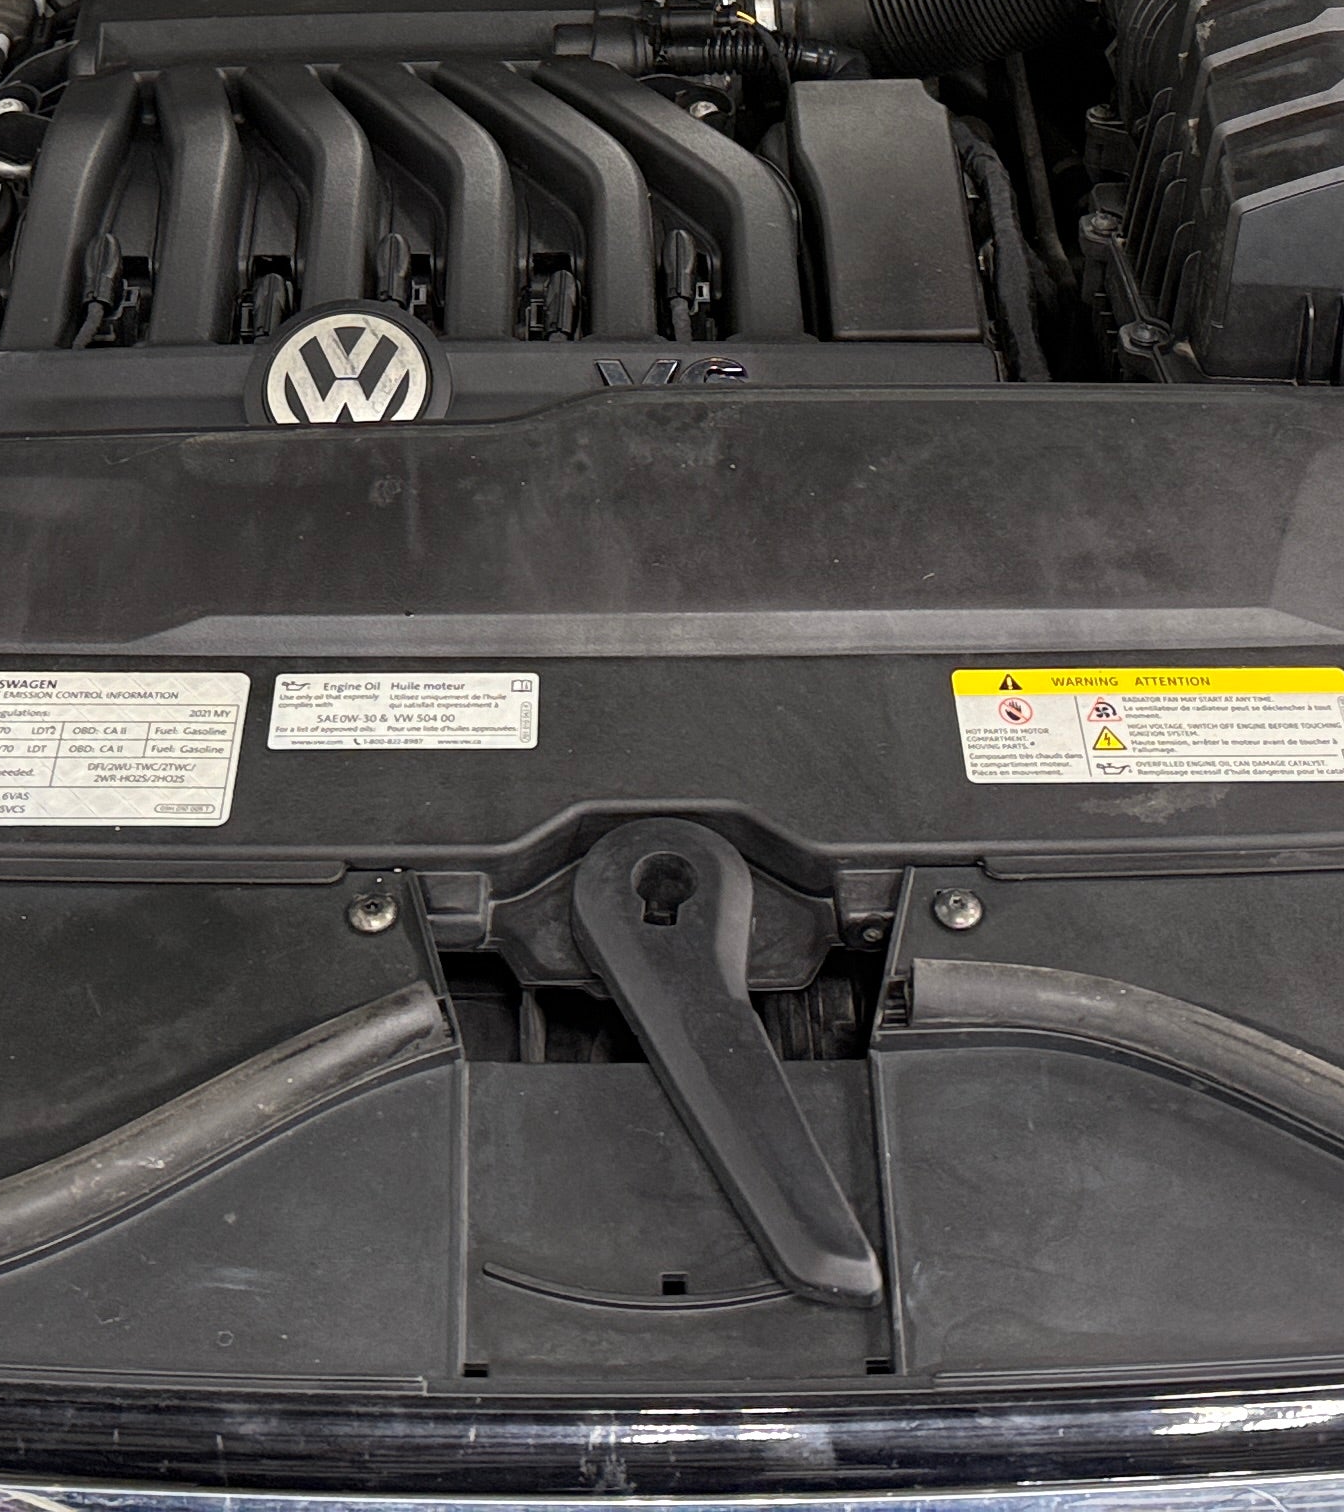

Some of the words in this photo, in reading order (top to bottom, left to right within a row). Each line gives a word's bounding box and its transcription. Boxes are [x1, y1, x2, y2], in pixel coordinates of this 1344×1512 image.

[1051, 676, 1118, 687] WARNING
[1135, 676, 1210, 686] ATTENTION
[323, 682, 362, 693] Engine
[365, 682, 381, 690] Oil
[391, 682, 420, 690] Huile
[424, 682, 465, 690] moteur
[4, 691, 53, 699] EMISSION
[56, 691, 103, 699] CONTROL
[107, 691, 179, 700] INFORMATION
[189, 710, 211, 718] 2021
[214, 710, 231, 718] MY
[379, 714, 388, 722] &
[394, 714, 413, 722] VW
[417, 714, 437, 722] 504
[441, 714, 455, 722] 00
[32, 726, 56, 735] LDT2
[73, 727, 98, 735] OBD:
[103, 727, 119, 735] CA
[155, 727, 178, 735] Fuel:
[183, 727, 227, 736] Gasoline
[27, 745, 47, 753] LDT
[69, 745, 95, 753] OBD:
[100, 745, 115, 753] CA
[151, 745, 175, 753] Fuel:
[180, 745, 224, 754] Gasoline
